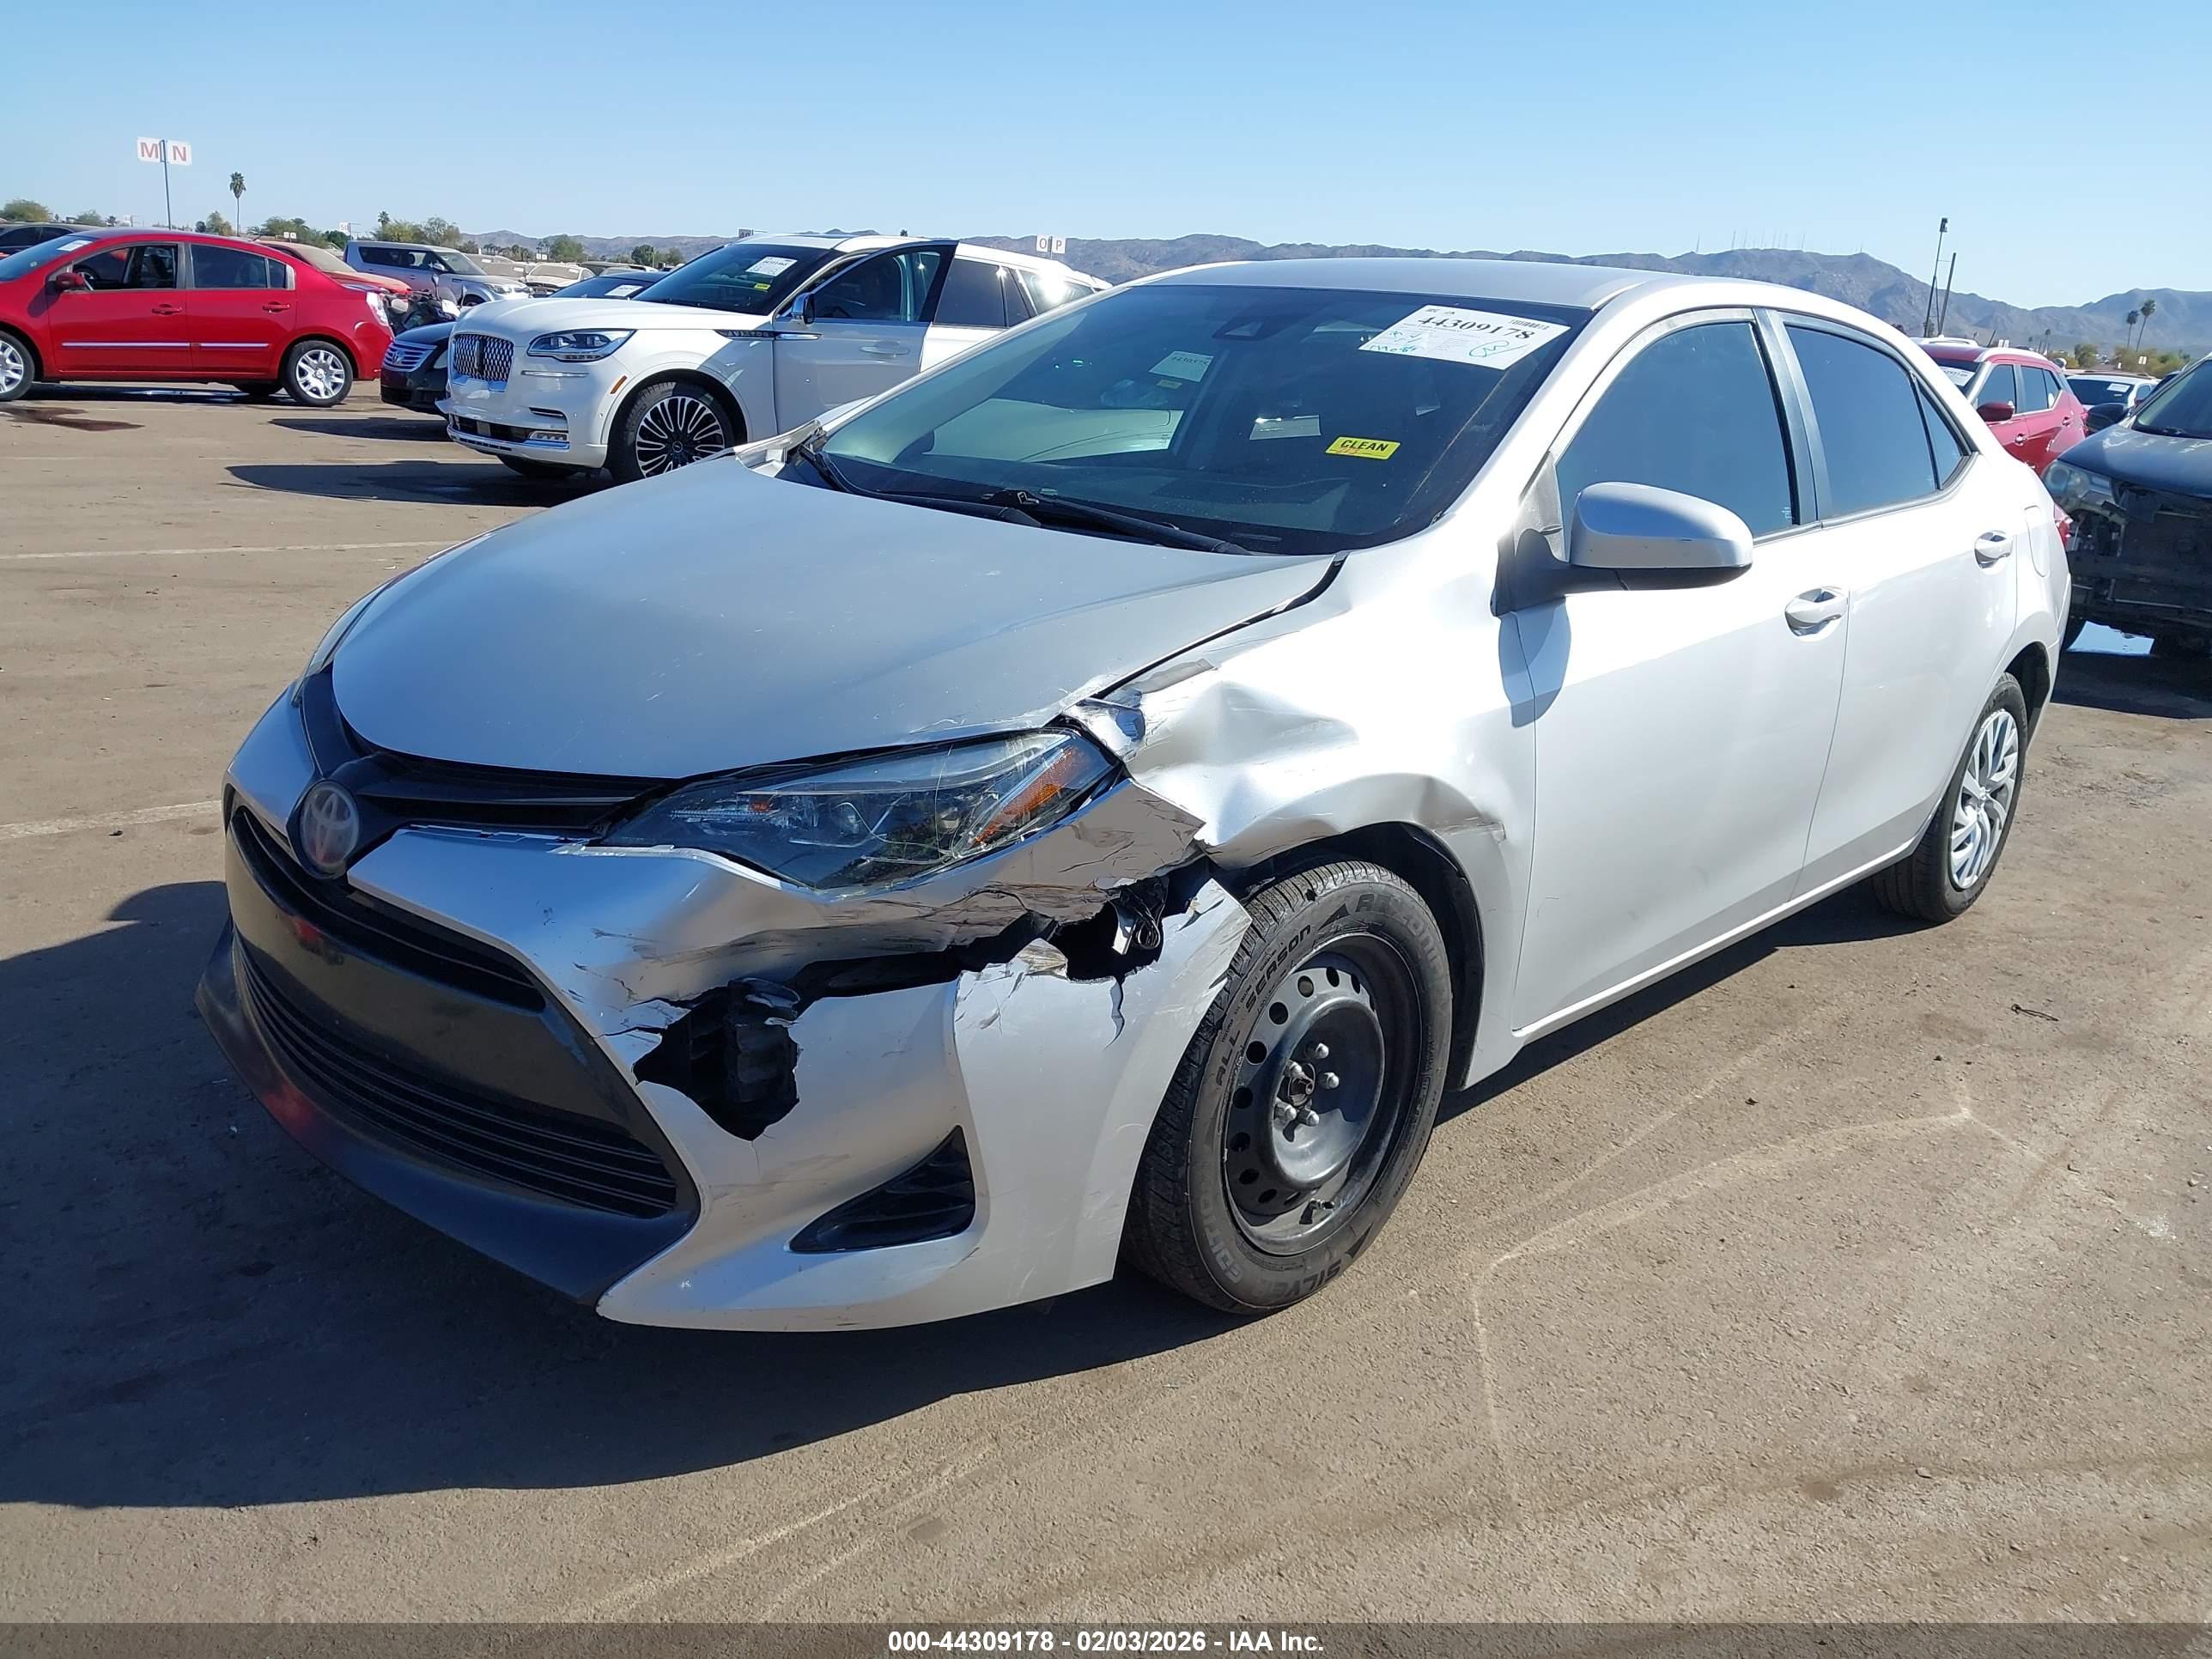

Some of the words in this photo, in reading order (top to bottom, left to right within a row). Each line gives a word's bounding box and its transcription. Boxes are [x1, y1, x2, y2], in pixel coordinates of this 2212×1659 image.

[140, 142, 159, 159] M
[172, 145, 186, 161] N
[1039, 238, 1048, 249] O
[1055, 240, 1062, 250] P
[1417, 316, 1535, 339] 44309178
[1340, 440, 1389, 452] CLEAN
[1215, 1029, 1242, 1086] ALL
[1243, 924, 1311, 1014] SEASON
